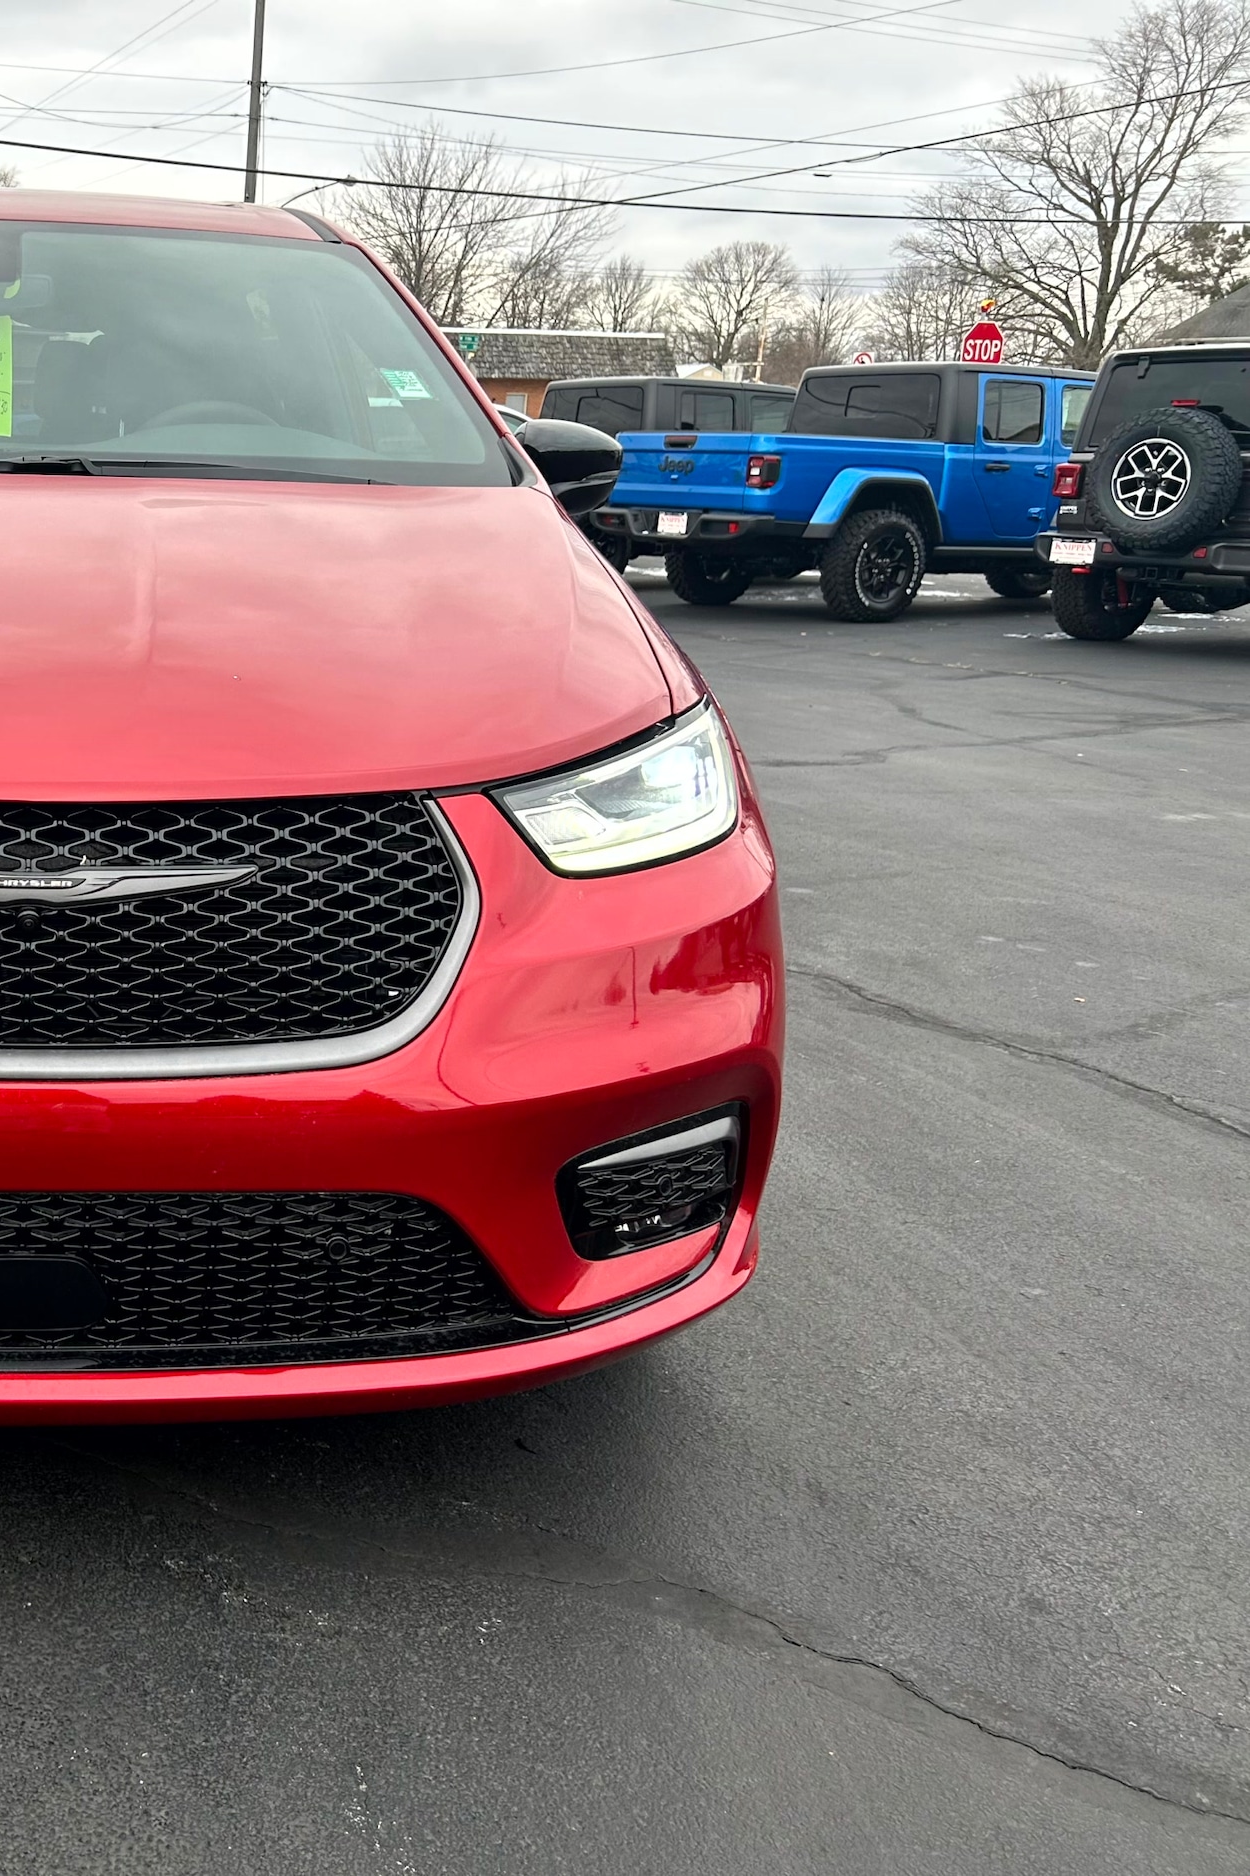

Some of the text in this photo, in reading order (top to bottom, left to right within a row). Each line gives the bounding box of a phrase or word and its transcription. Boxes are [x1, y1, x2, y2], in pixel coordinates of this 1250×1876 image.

[963, 339, 1001, 361] STOP
[658, 456, 695, 475] Jeep
[1054, 542, 1093, 552] KNIPPEN
